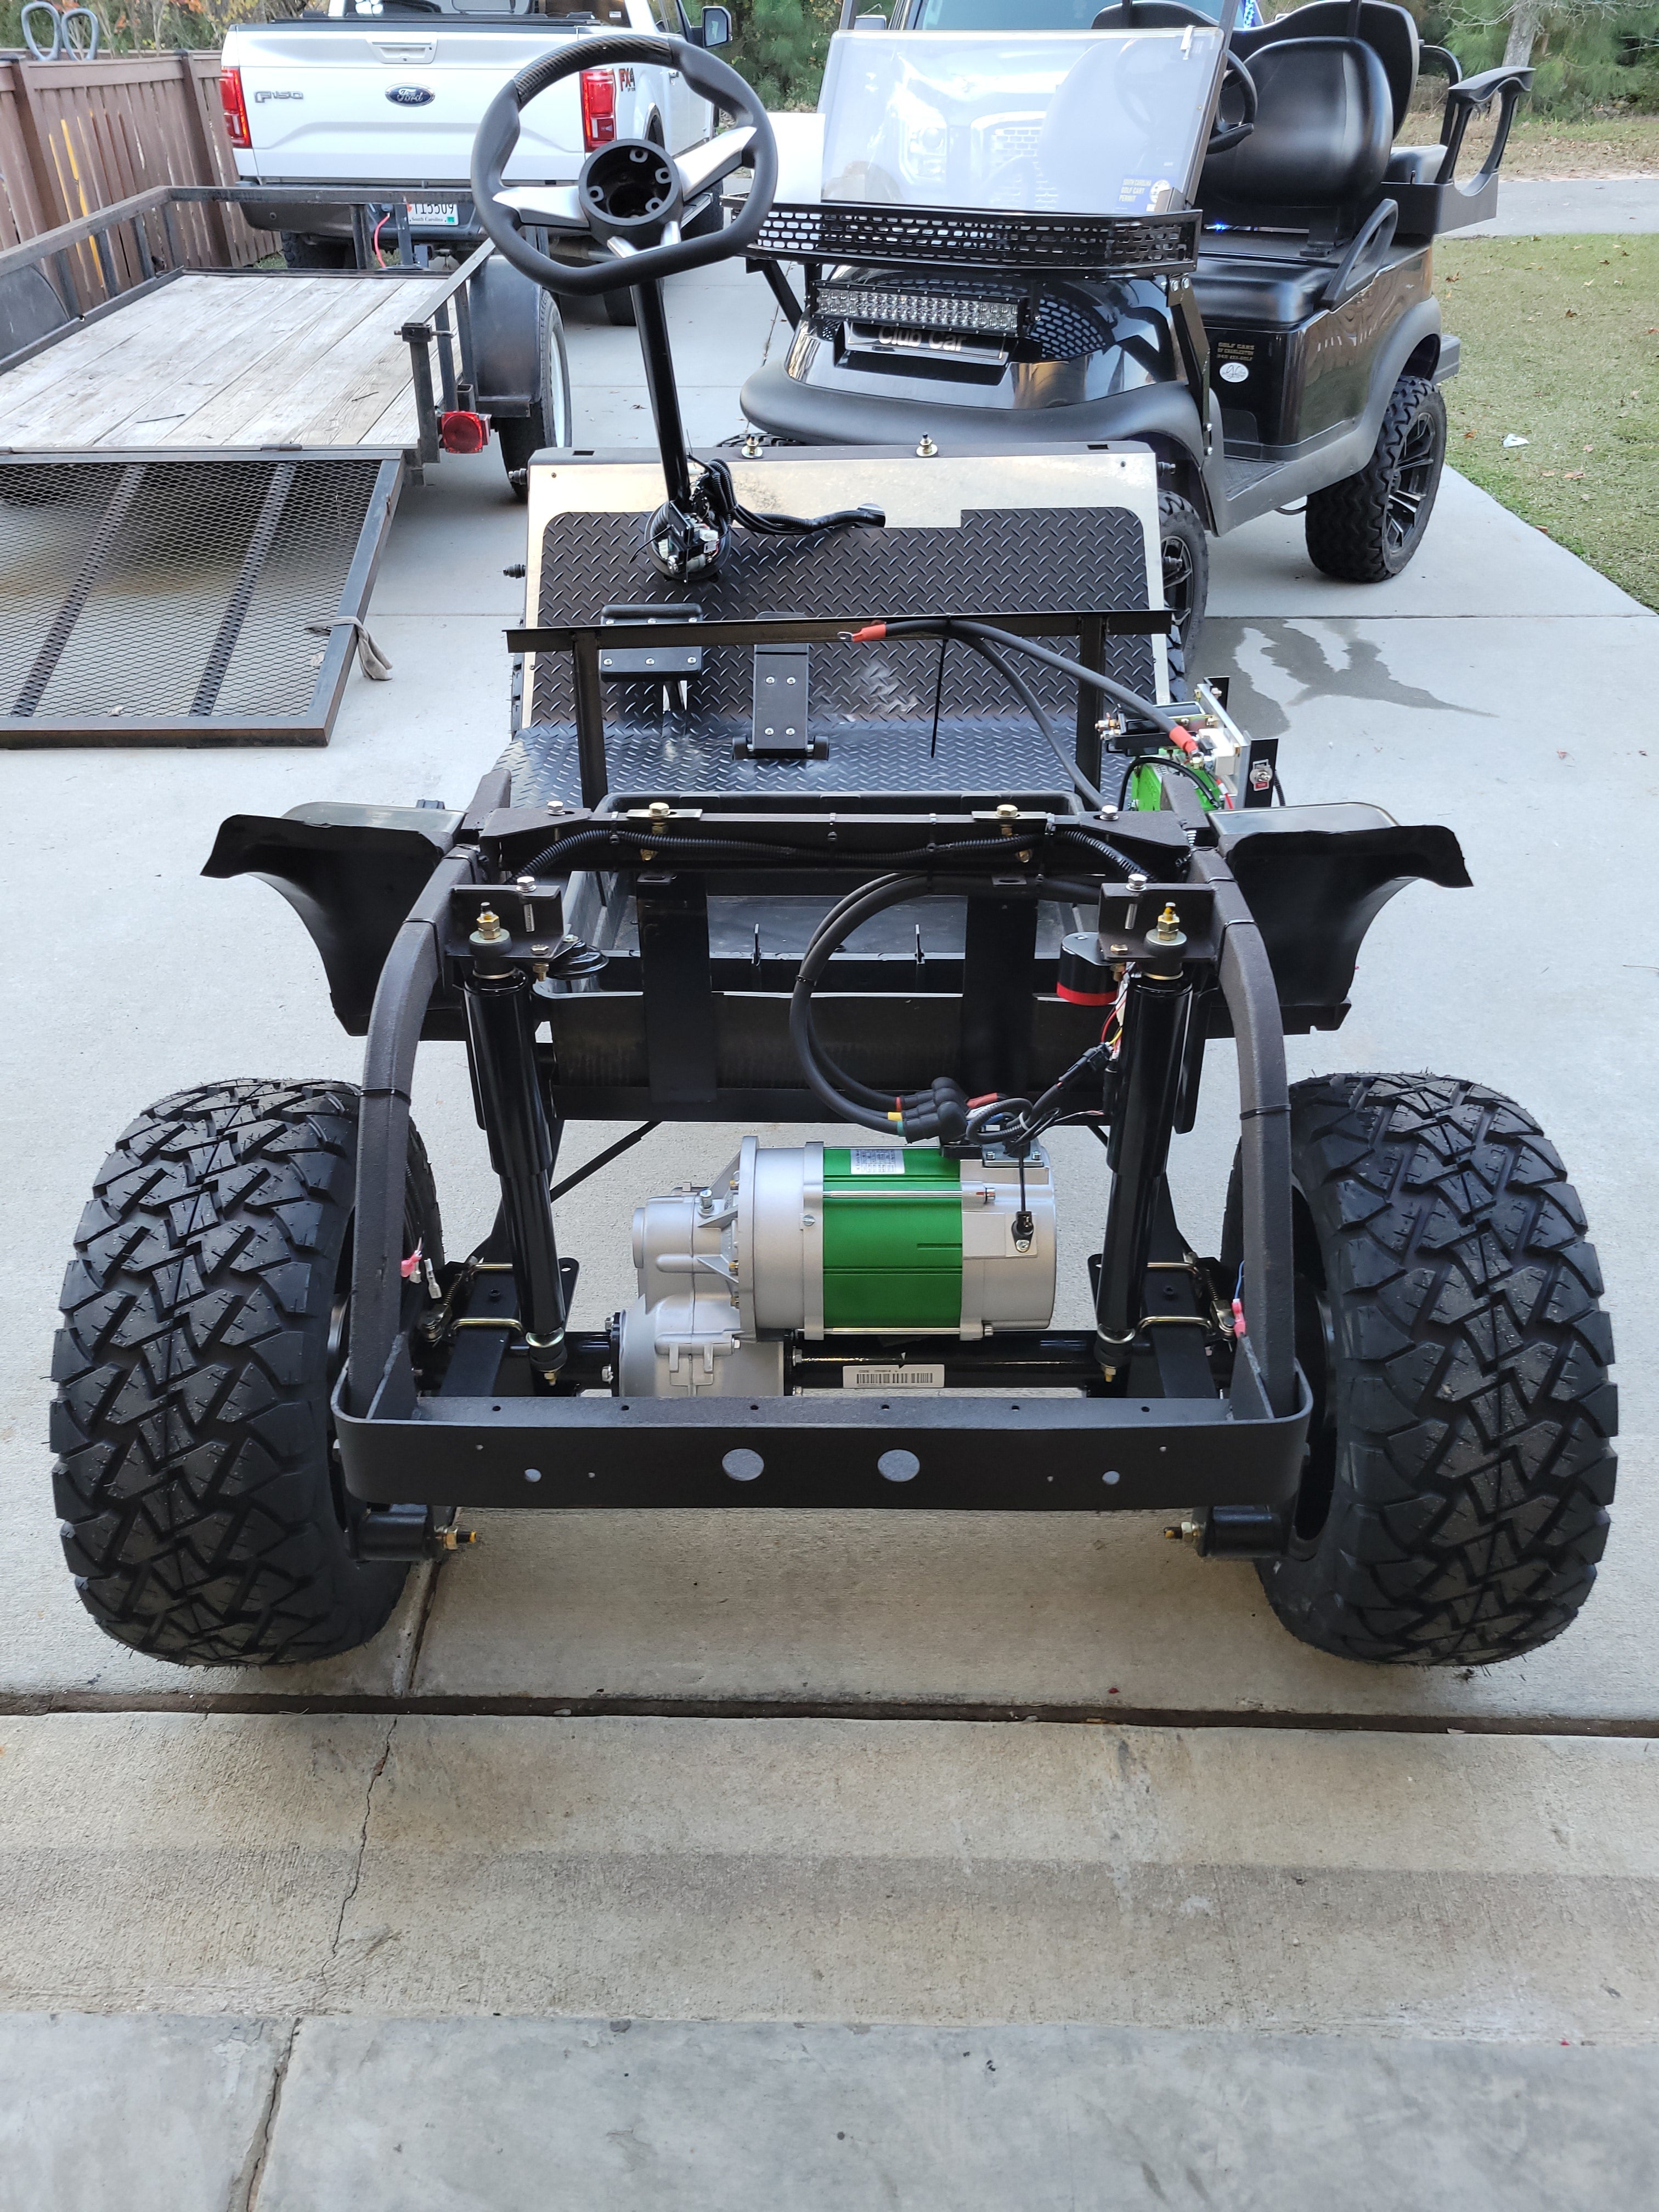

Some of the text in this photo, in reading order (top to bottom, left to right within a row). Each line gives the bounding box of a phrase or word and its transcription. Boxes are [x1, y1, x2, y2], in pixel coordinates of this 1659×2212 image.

[397, 88, 423, 101] Ford
[879, 325, 967, 351] Club Car
